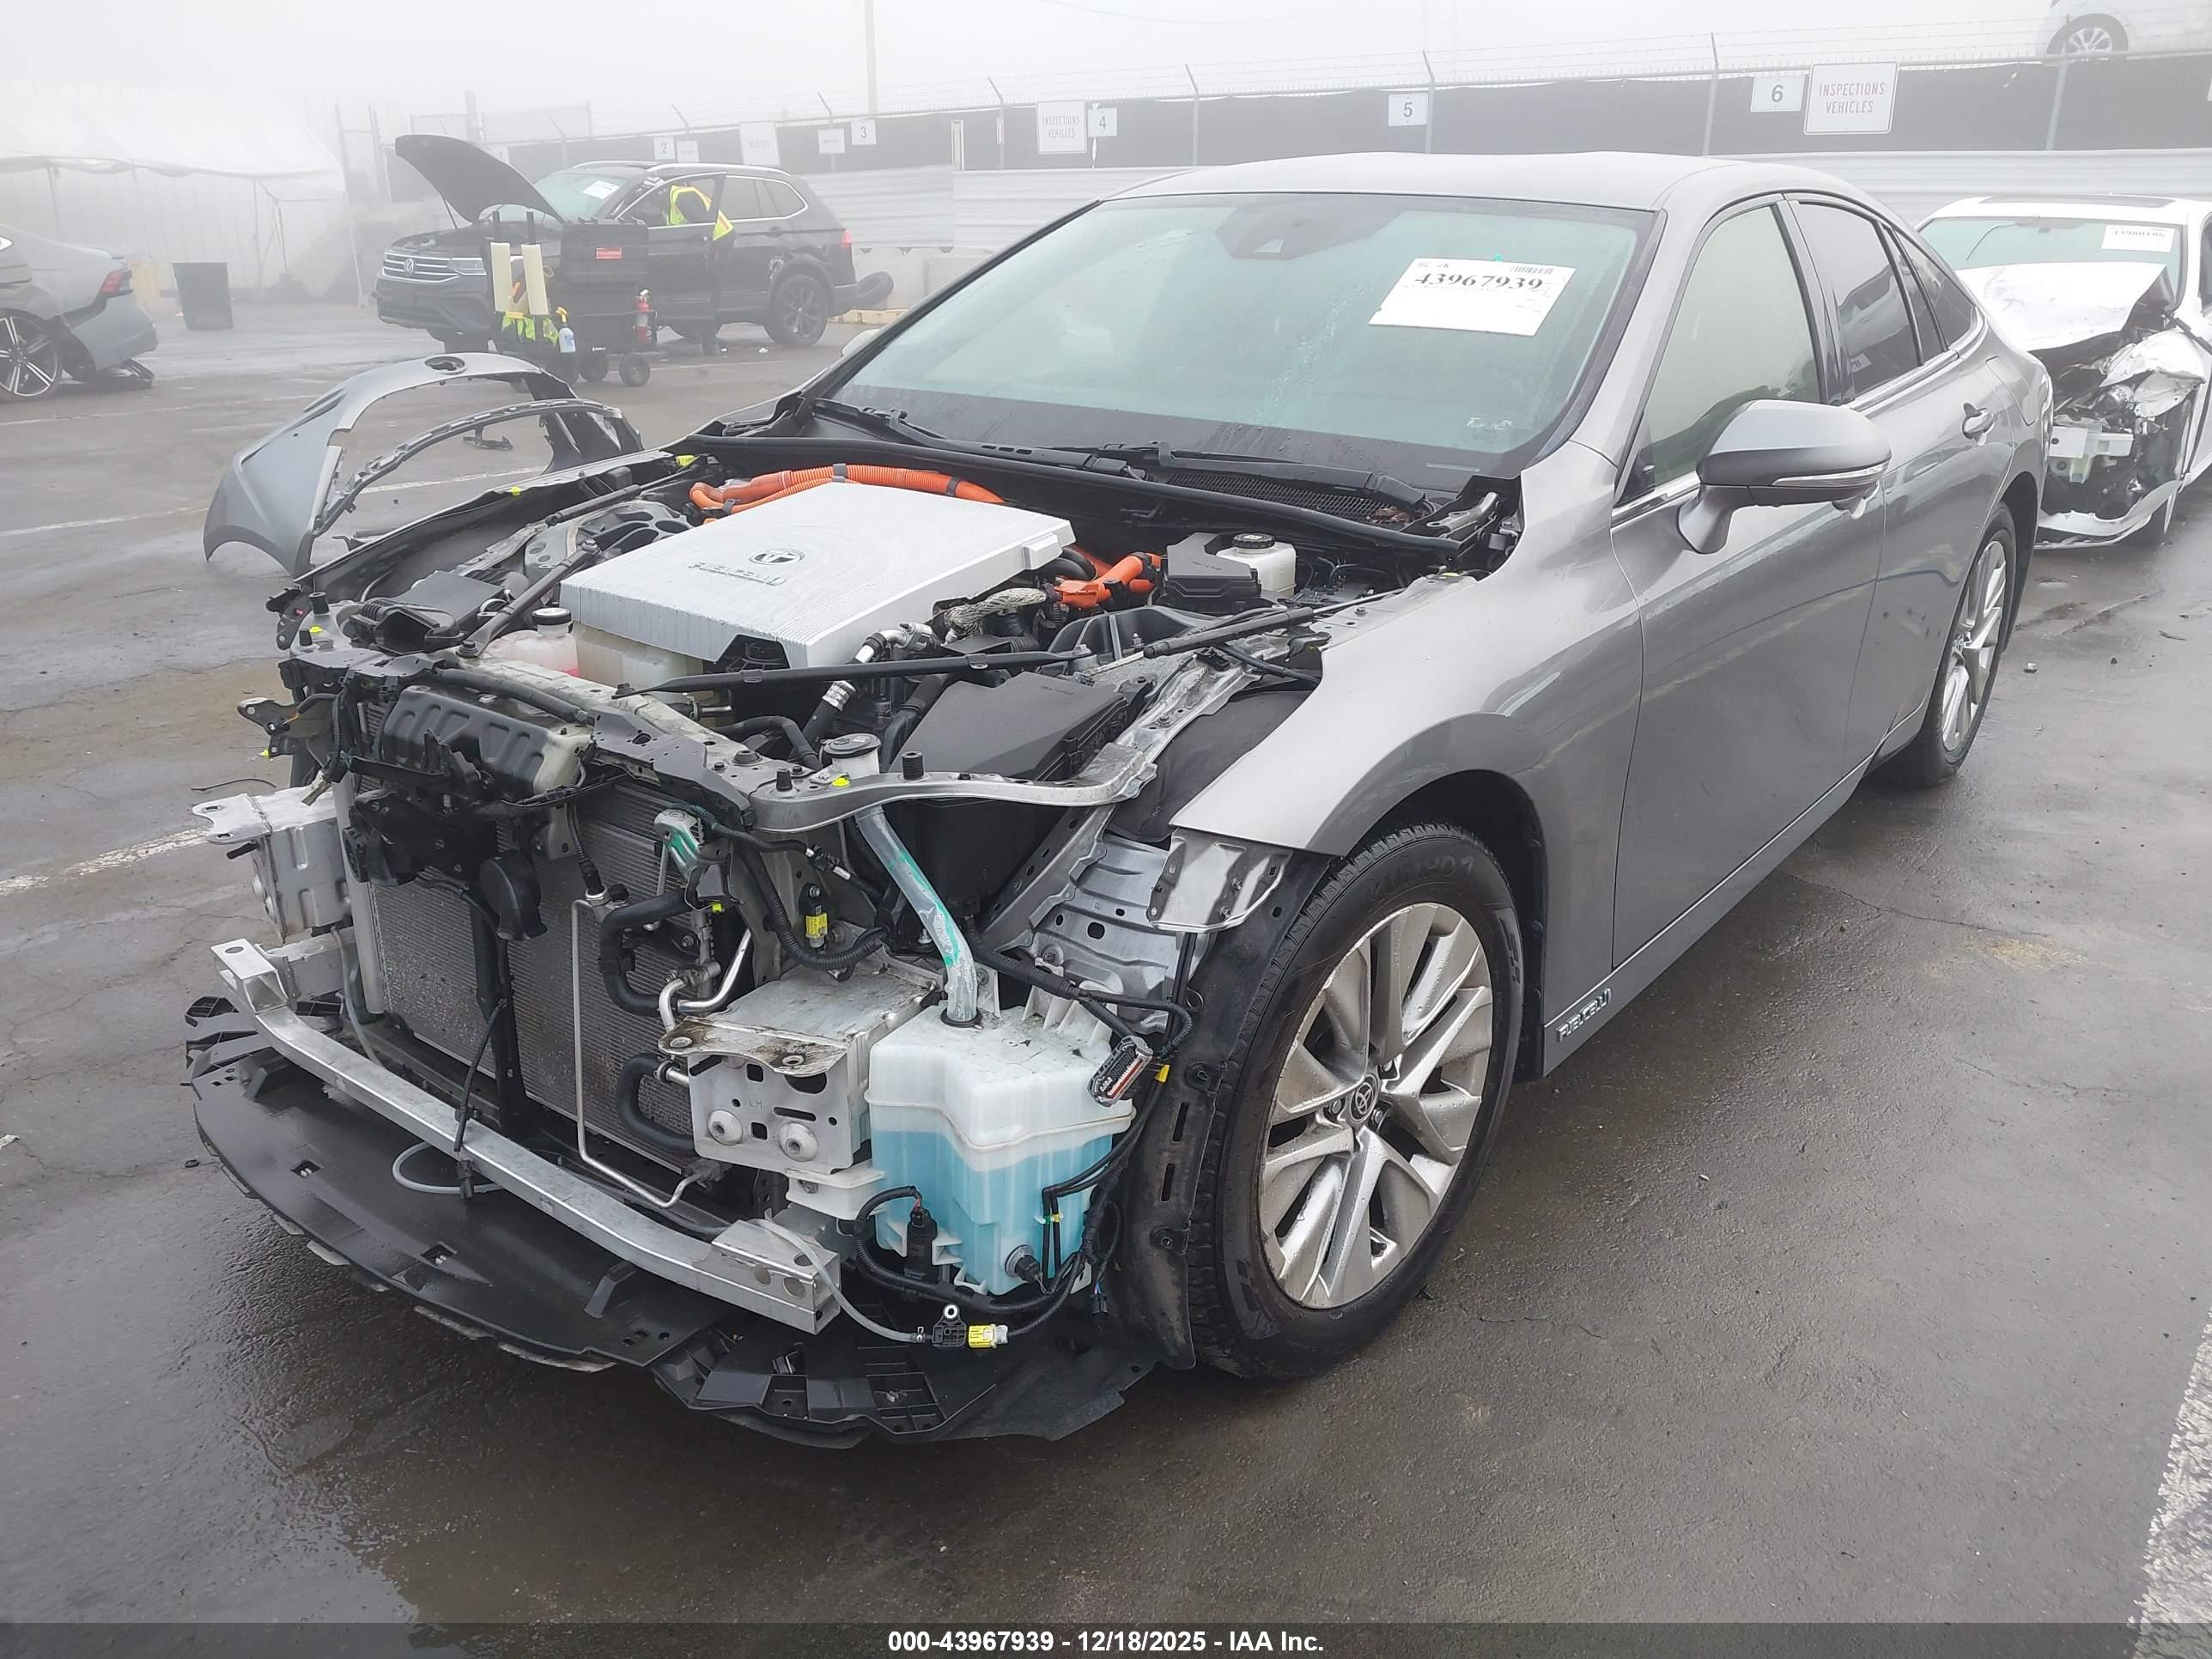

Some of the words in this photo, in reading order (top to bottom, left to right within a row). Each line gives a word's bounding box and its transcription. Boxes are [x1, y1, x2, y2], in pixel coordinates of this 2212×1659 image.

[1771, 84, 1784, 102] 6
[1819, 82, 1886, 96] INSPECTIONS
[1403, 102, 1413, 118] 5
[1826, 100, 1875, 113] VEHICLES
[1042, 115, 1080, 125] INSPECTIONS
[1098, 116, 1107, 130] 4
[860, 126, 867, 139] 3
[1048, 129, 1076, 138] VEHICLES
[661, 143, 667, 154] 2
[1414, 272, 1544, 290] 43967939
